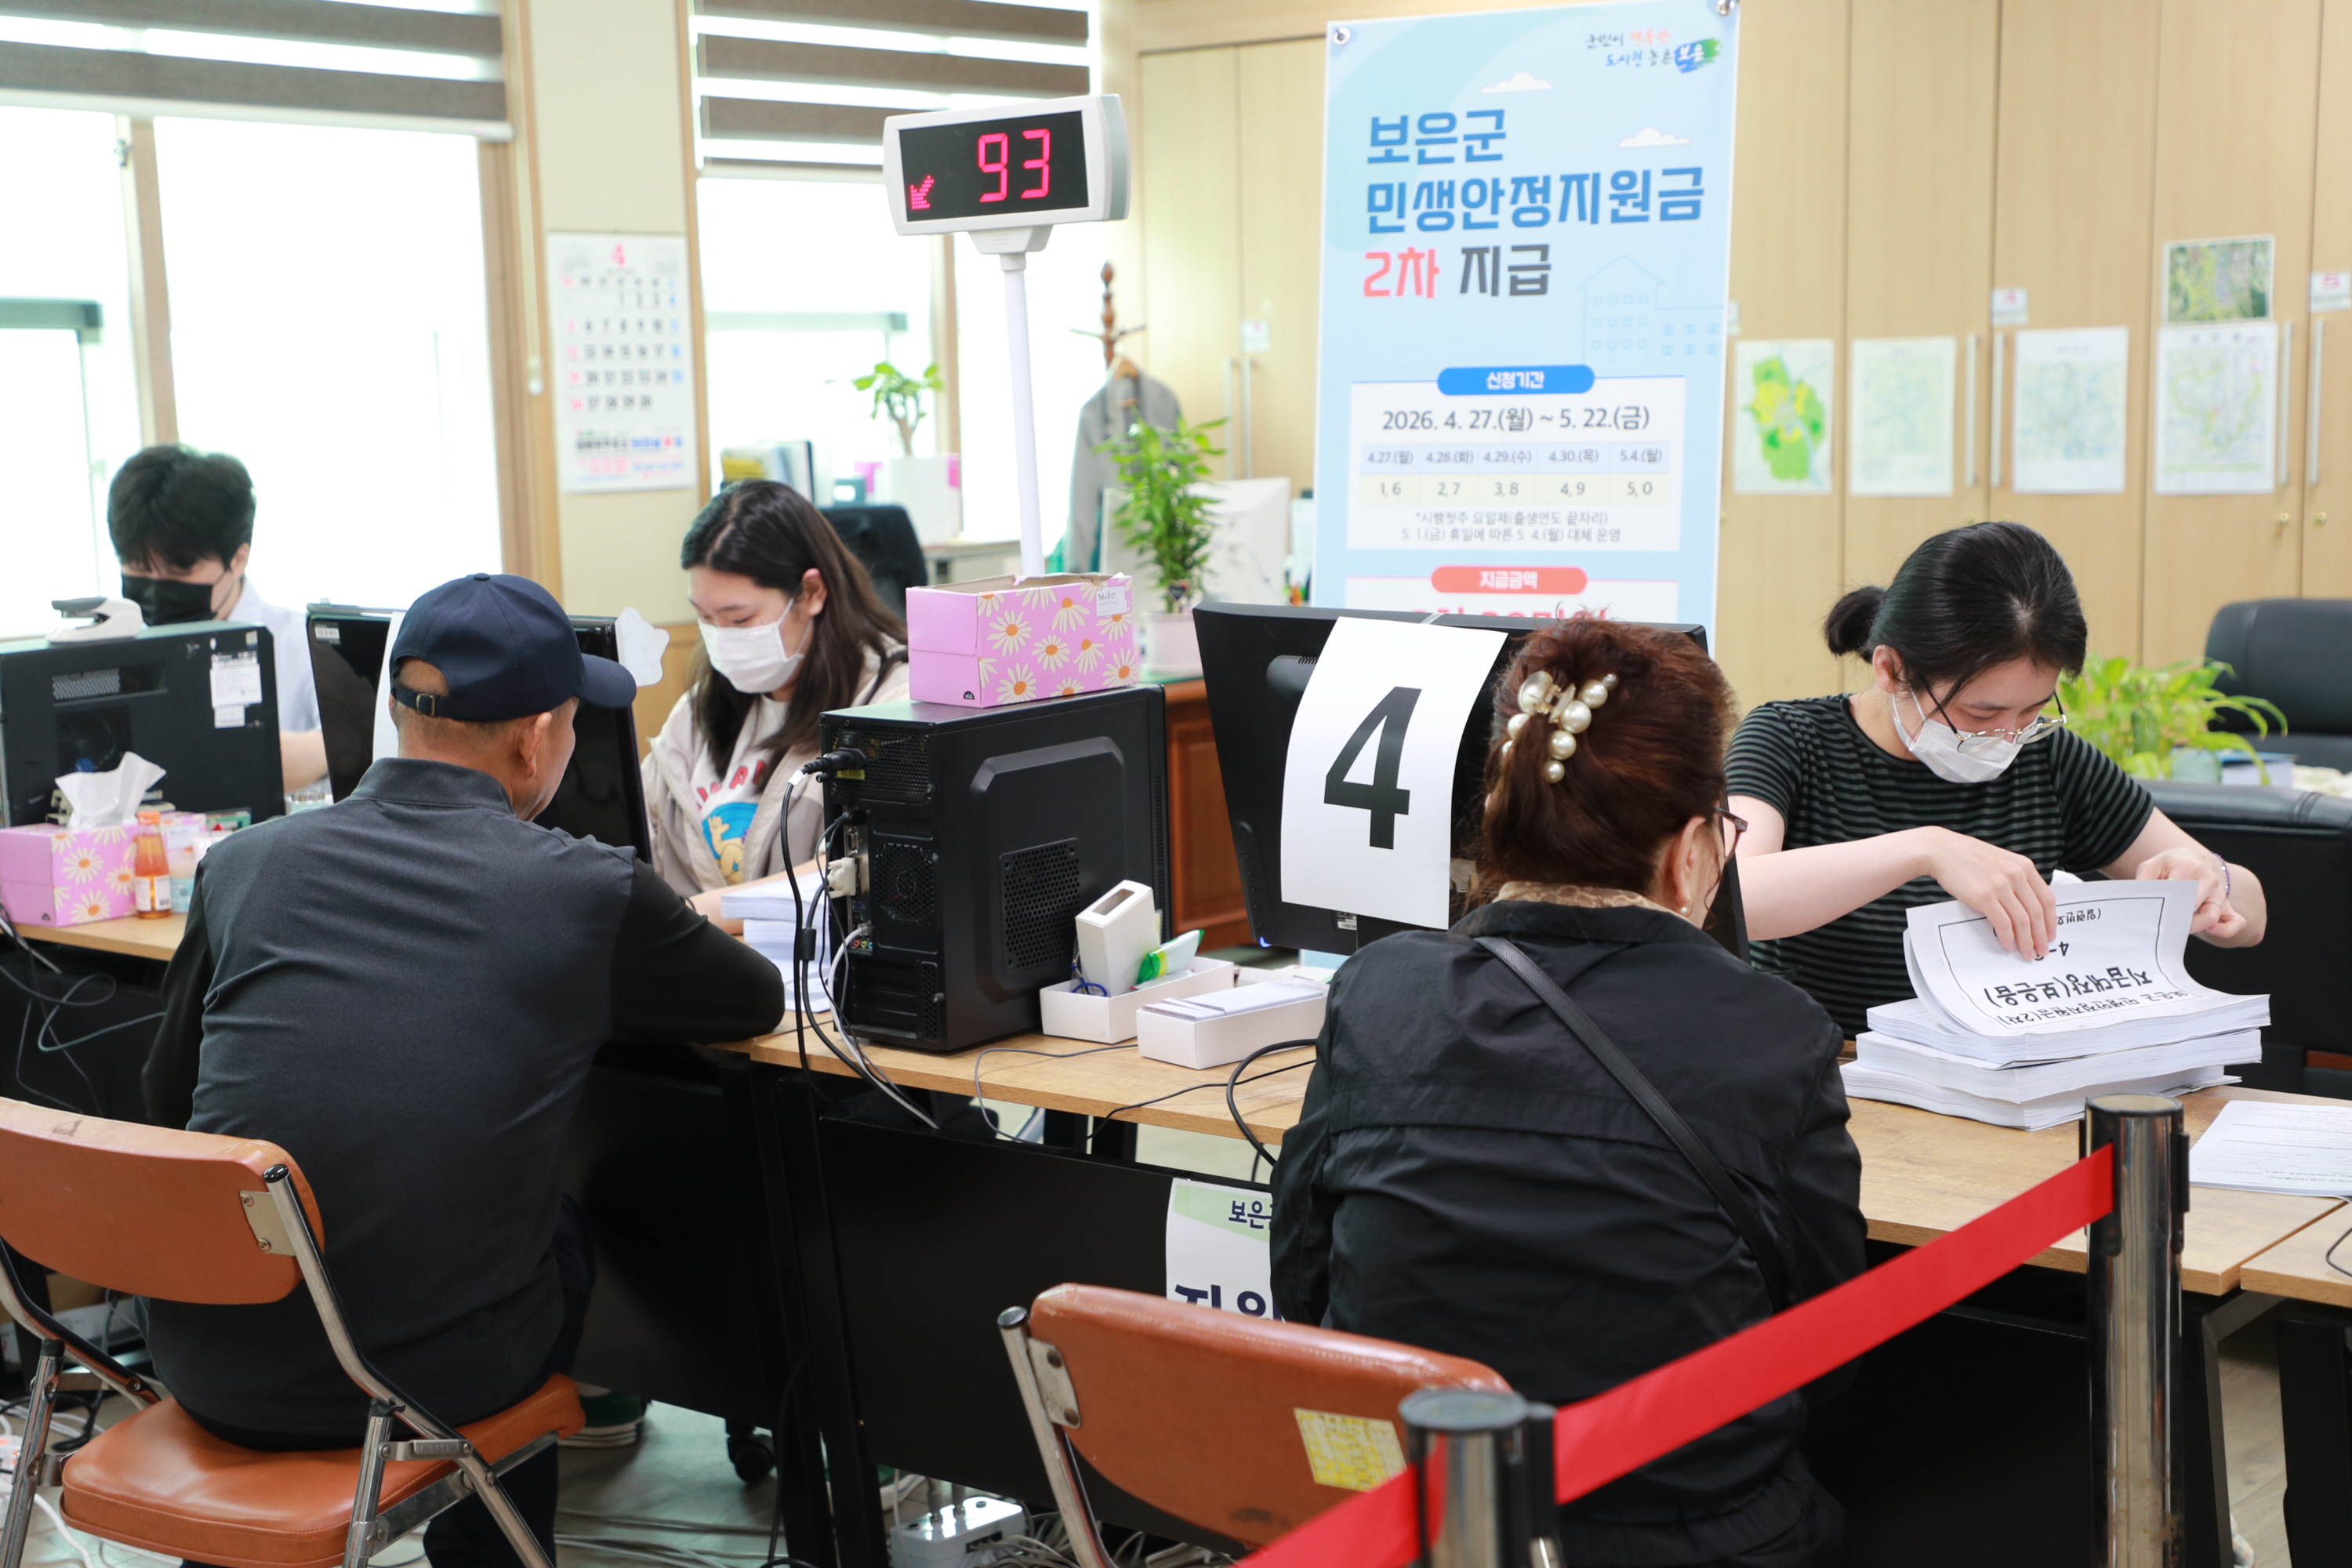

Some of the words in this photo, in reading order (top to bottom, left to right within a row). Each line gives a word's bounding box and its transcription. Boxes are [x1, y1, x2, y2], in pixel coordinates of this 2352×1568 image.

[1678, 43, 1704, 63] 보은
[1367, 108, 1506, 165] 보은군
[978, 128, 1051, 203] 93
[1367, 166, 1704, 234] 민생안정지원금
[612, 243, 626, 267] 4
[1363, 245, 1440, 299] 2차
[1460, 243, 1552, 297] 지급
[1486, 371, 1545, 390] 신청기간
[1382, 410, 1438, 430] 2026.
[1443, 410, 1462, 430] 4.
[1468, 406, 1534, 432] 27.(월)
[1559, 408, 1577, 428] 5.
[1583, 405, 1650, 430] 22.(금)
[1367, 450, 1414, 465] 4.27.(월)
[1425, 450, 1474, 464] 4.28.(화)
[1483, 449, 1532, 464] 4.29.(수)
[1549, 448, 1599, 463] 4.30.(목)
[1620, 448, 1663, 463] 5.4.(월)
[1490, 528, 1513, 542] 따른
[1568, 528, 1592, 542] 대체
[1597, 528, 1621, 543] 운영
[1479, 570, 1538, 589] 지급금액
[1323, 686, 1422, 850] 4
[2034, 942, 2069, 961] 4-
[1984, 966, 2153, 1008] 지급대장(보은읍)
[1229, 1200, 1272, 1231] 보은
